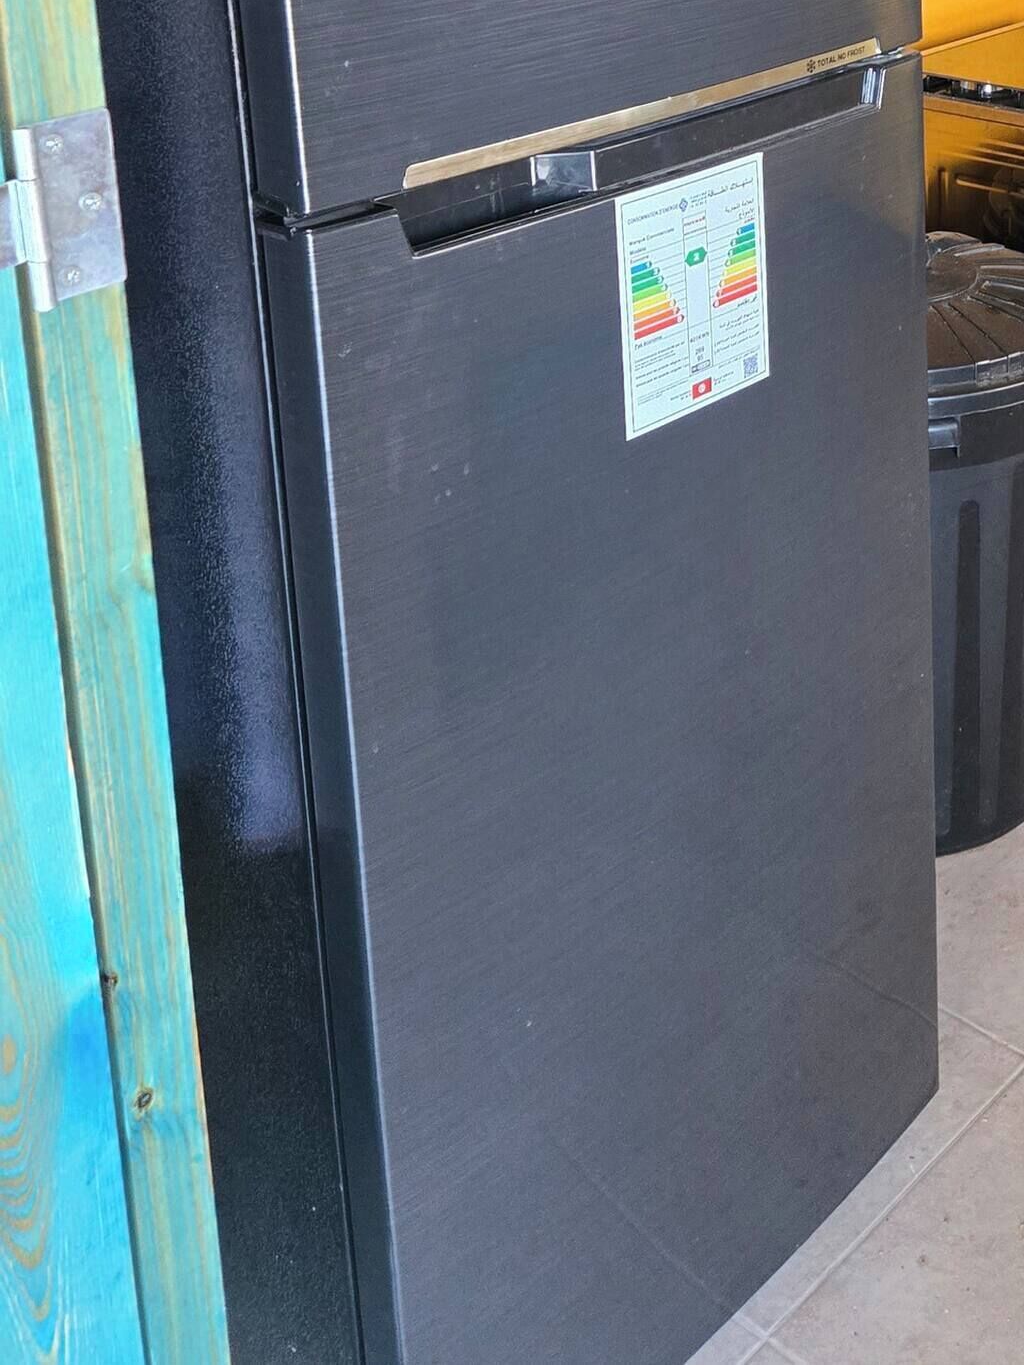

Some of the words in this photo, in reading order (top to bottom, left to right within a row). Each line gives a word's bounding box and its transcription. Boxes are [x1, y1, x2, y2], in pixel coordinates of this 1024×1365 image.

[817, 56, 836, 67] TOTAL
[837, 52, 846, 60] NO
[847, 46, 865, 58] FROST
